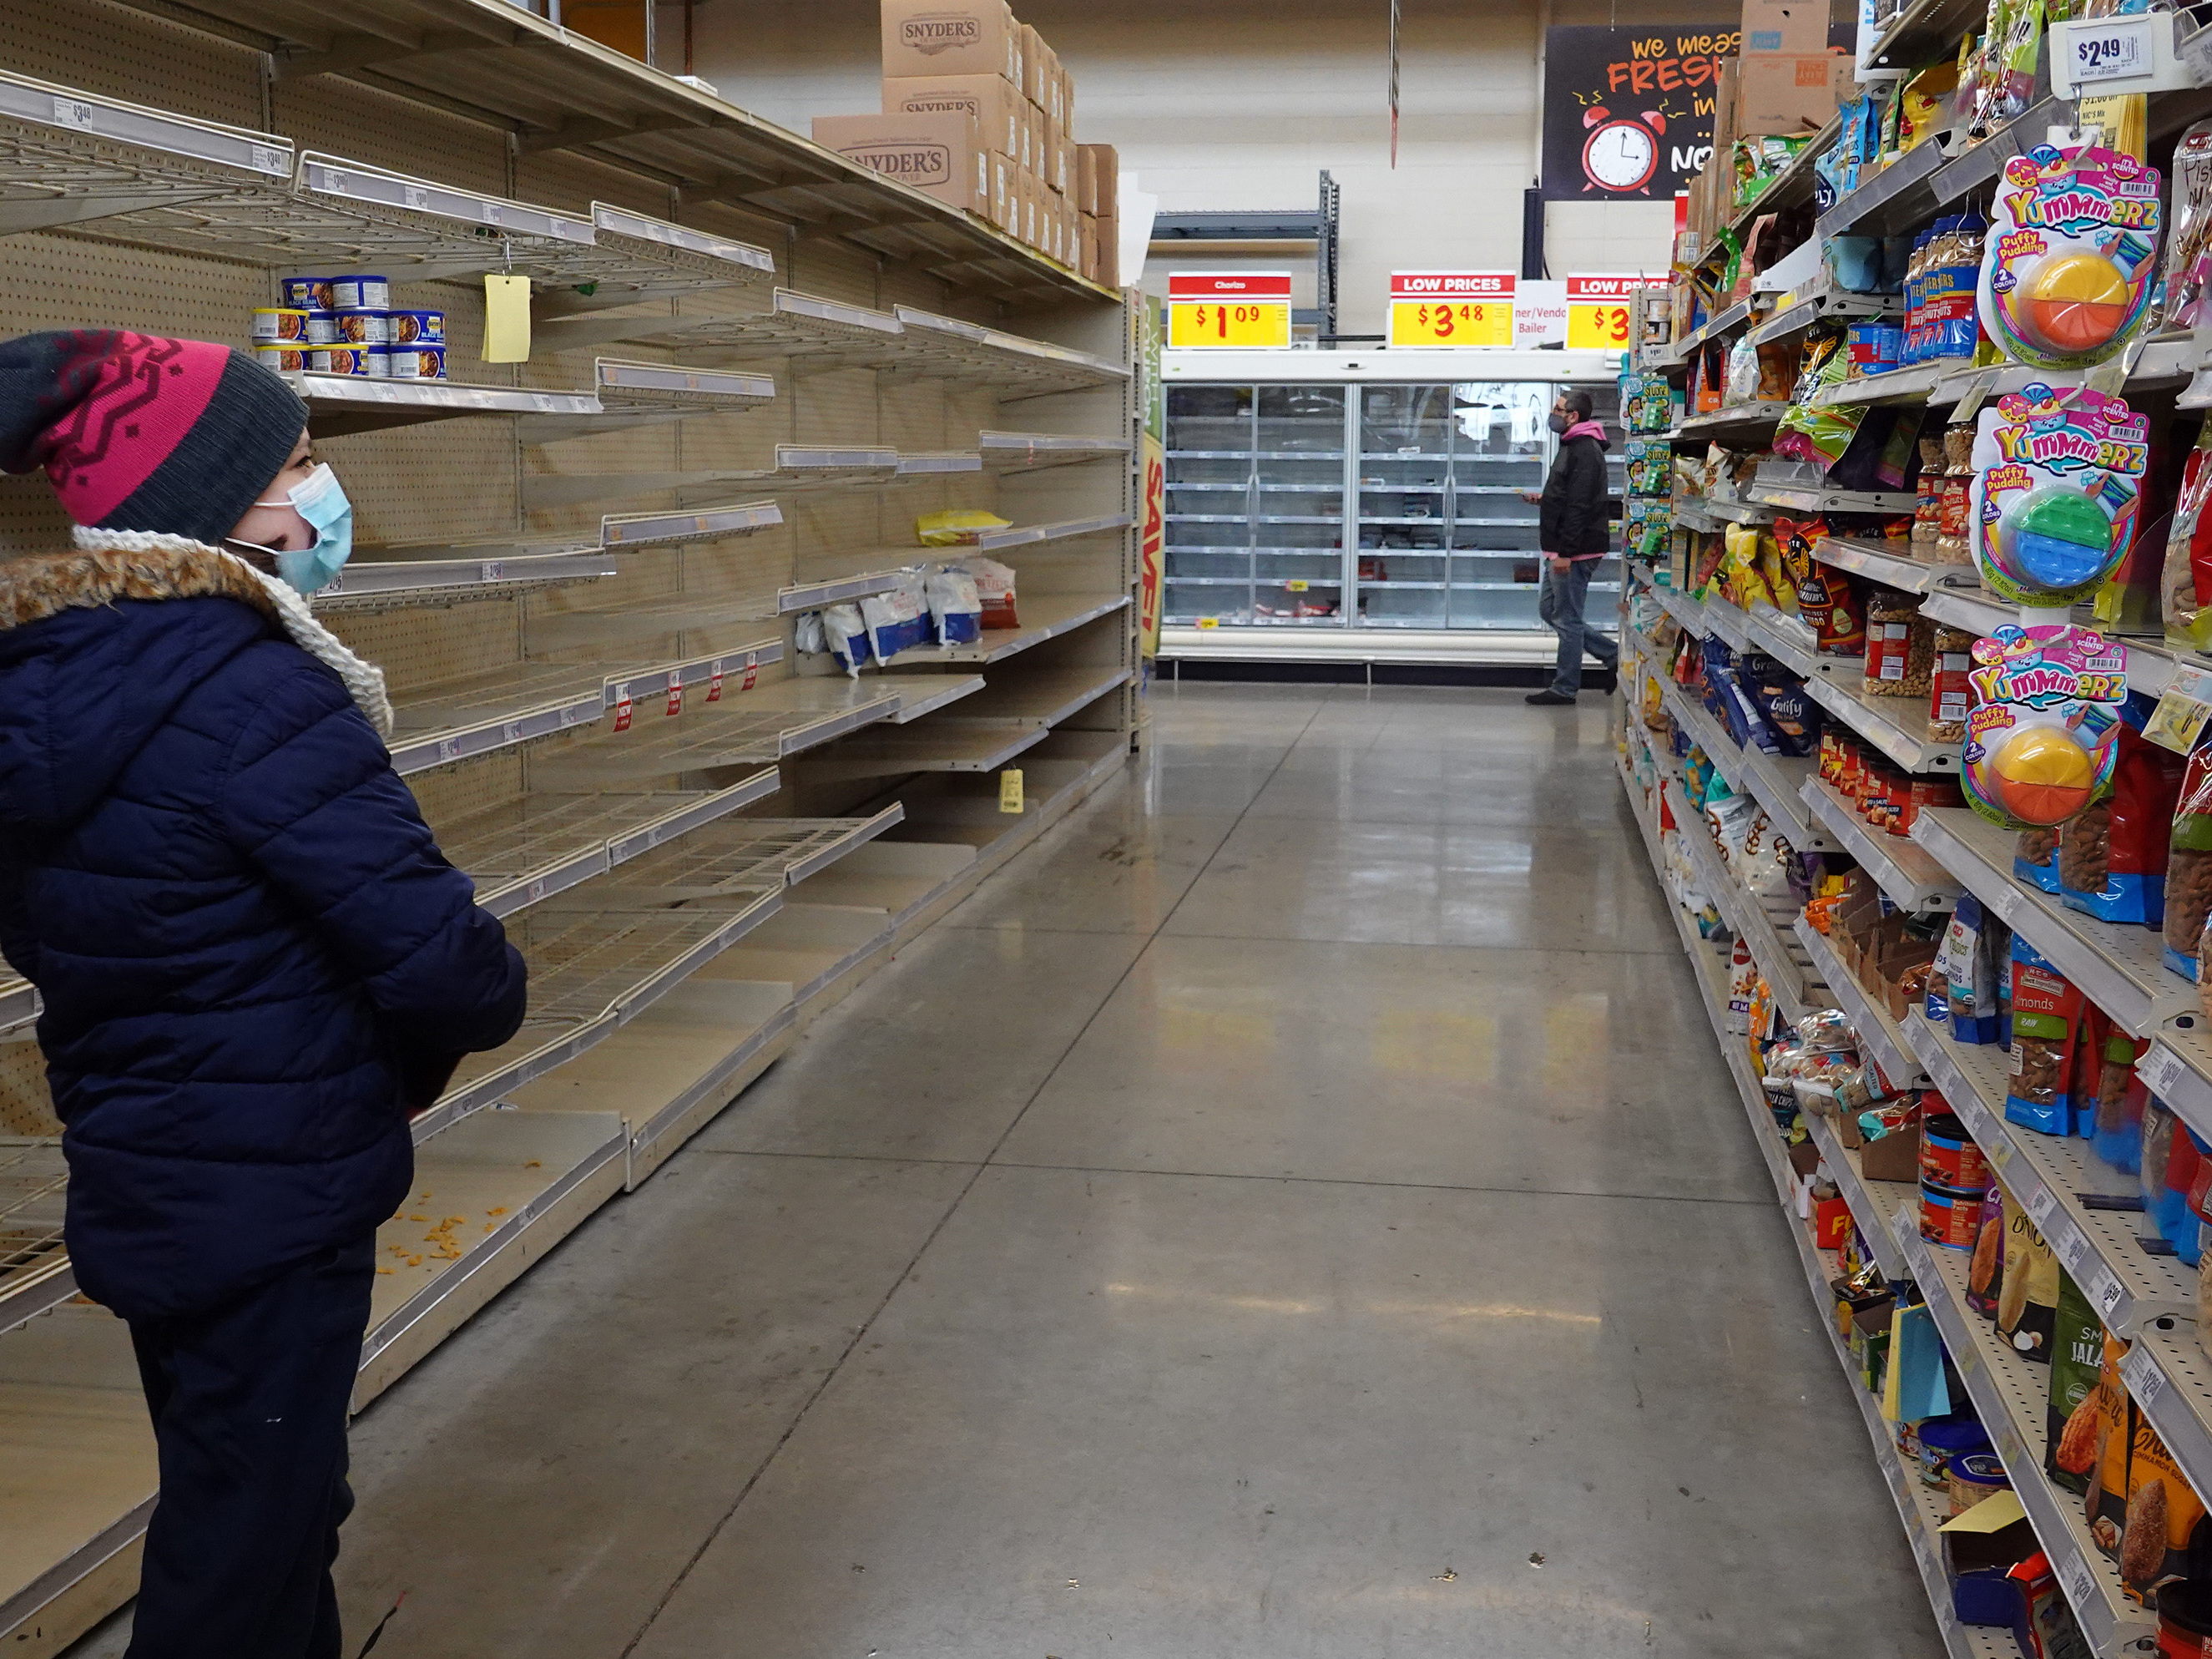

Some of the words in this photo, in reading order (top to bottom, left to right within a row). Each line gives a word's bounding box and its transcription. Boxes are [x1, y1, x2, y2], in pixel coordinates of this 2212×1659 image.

[906, 21, 975, 38] SNYDER'S
[1631, 38, 1667, 59] we
[2078, 38, 2120, 67] $249
[2112, 163, 2139, 174] SCENTED
[2002, 233, 2038, 248] Puffy
[2000, 242, 2045, 259] Pudding
[1998, 269, 2008, 280] 2
[1404, 278, 1441, 291] LOW
[1445, 278, 1501, 291] PRICES
[1580, 281, 1619, 294] LOW
[1993, 278, 2017, 290] COLORS
[1518, 323, 1548, 333] Bailer
[1645, 388, 1666, 397] SLUDGE
[2103, 407, 2129, 419] SCENTED
[1989, 467, 2024, 480] Puffy
[1987, 477, 2031, 491] Pudding
[1985, 501, 1992, 512] 2
[1982, 510, 2000, 519] COLORS
[2077, 640, 2104, 650] SCENTED
[1973, 707, 2006, 722] Puffy
[1971, 716, 2013, 733] Pudding
[1969, 741, 1977, 751] 2
[1964, 749, 1985, 761] COLORS
[2022, 1018, 2038, 1027] RAW
[2134, 1450, 2170, 1472] CINNAMON
